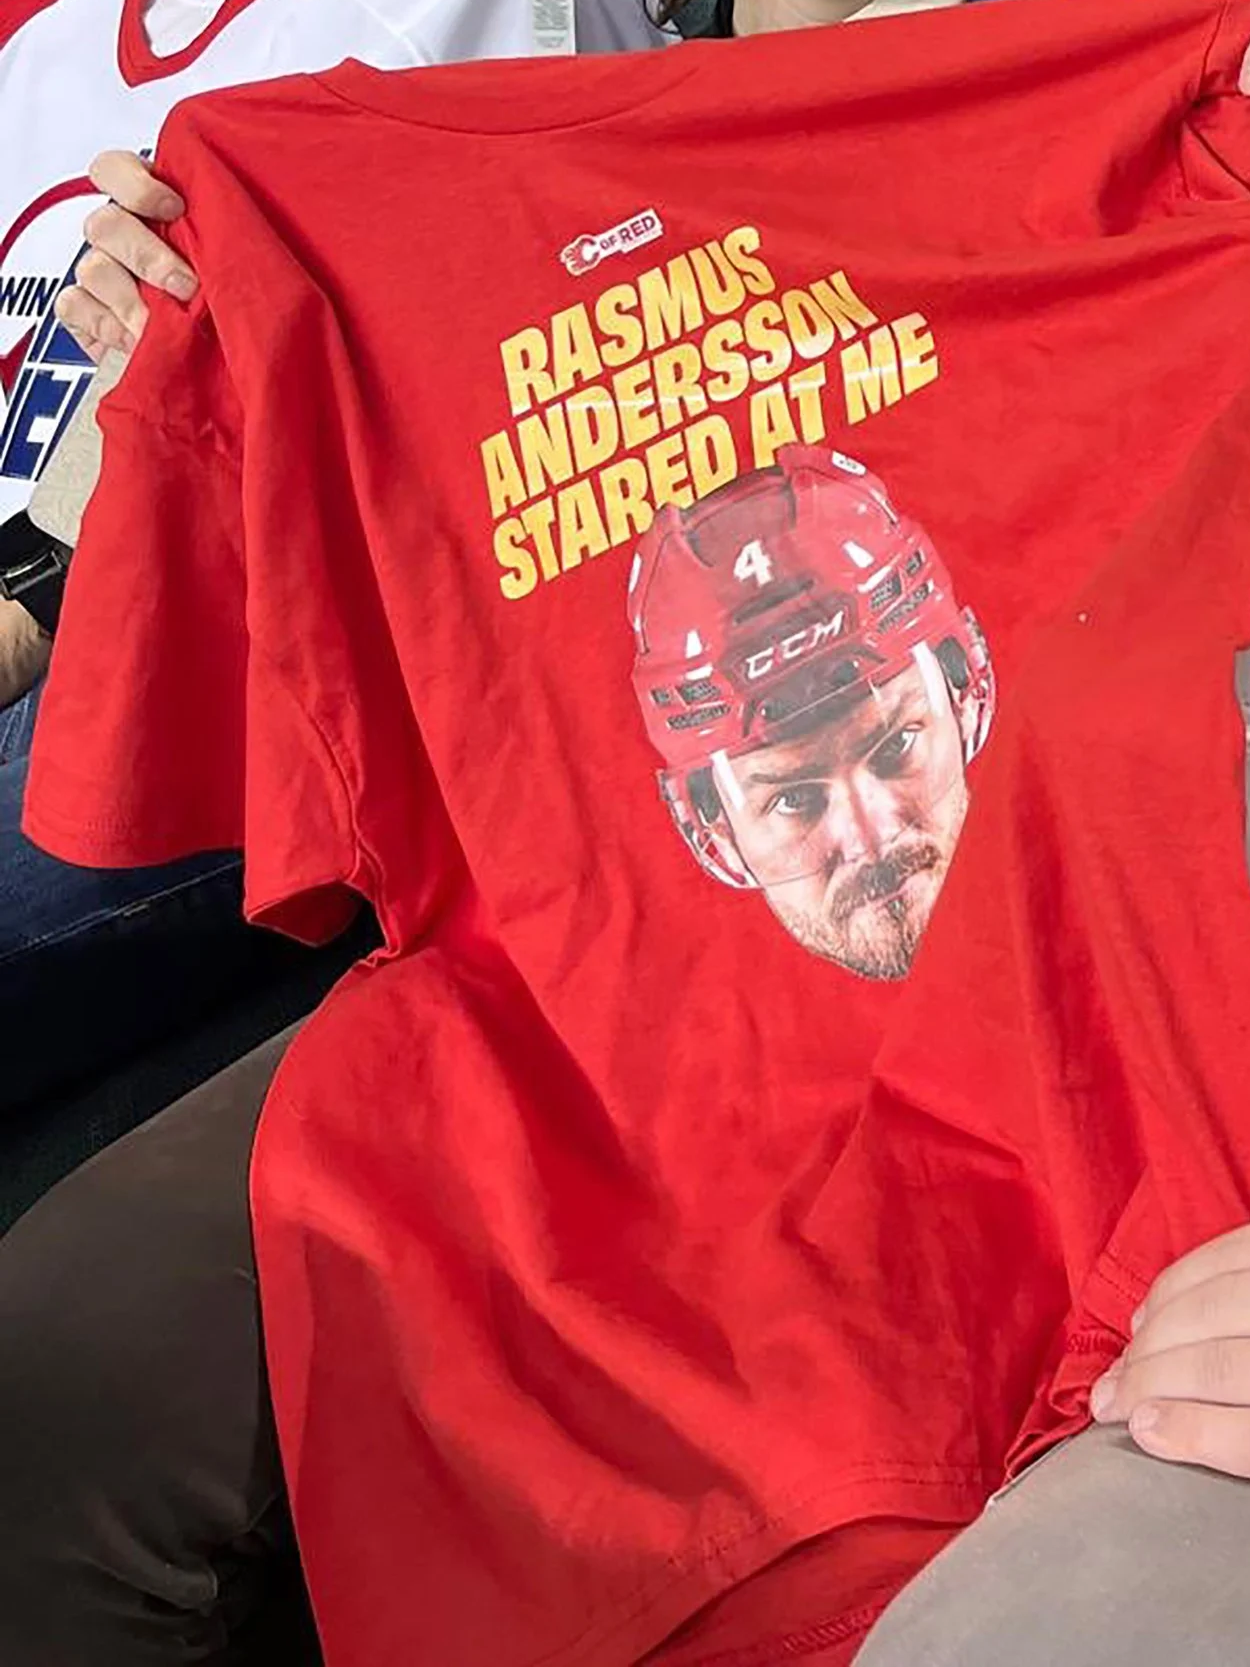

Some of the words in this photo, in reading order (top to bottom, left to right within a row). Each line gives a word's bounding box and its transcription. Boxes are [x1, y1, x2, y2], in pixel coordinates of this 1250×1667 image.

[599, 235, 618, 251] OF
[619, 215, 657, 245] RED
[499, 225, 776, 417] RASMUS
[479, 270, 880, 519] ANDERSSON
[491, 413, 738, 601] STARED
[749, 362, 828, 477] AT
[841, 311, 940, 426] ME
[733, 539, 773, 588] 4
[745, 610, 844, 680] CCM
